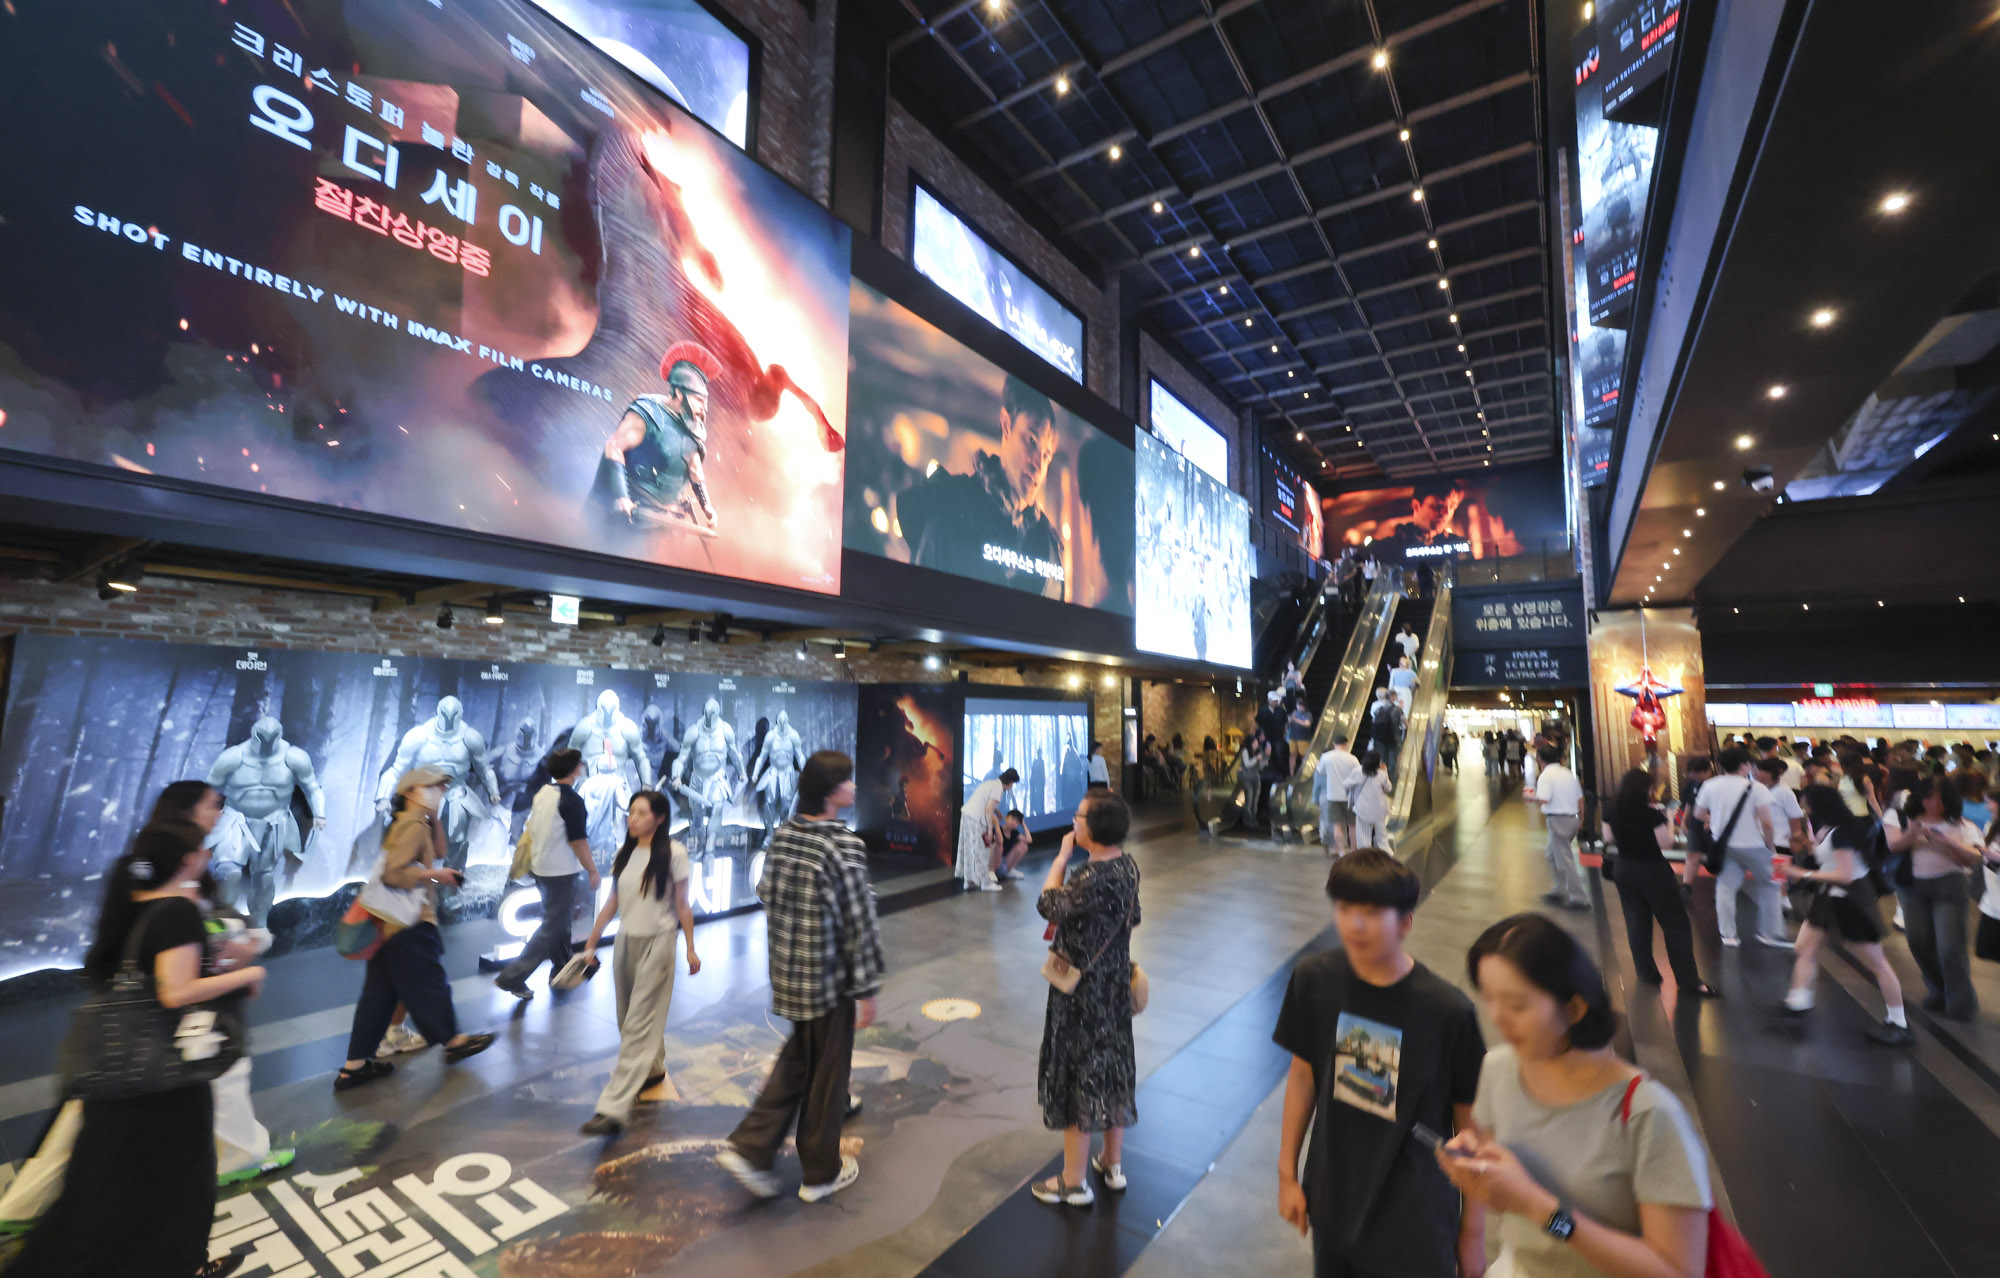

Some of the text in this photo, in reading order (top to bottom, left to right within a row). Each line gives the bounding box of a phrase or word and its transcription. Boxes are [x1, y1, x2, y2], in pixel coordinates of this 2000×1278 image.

[231, 21, 561, 210] 크리스토퍼 놀란 감독 작품
[249, 84, 543, 256] 오디세이
[314, 176, 492, 277] 절찬상영중
[73, 205, 613, 402] SHOT ENTIRELY WITH IMAX FILM CAMERAS
[982, 543, 1035, 574] 오디세우스는
[1483, 602, 1507, 616] 모든
[1512, 650, 1549, 659] IMAX
